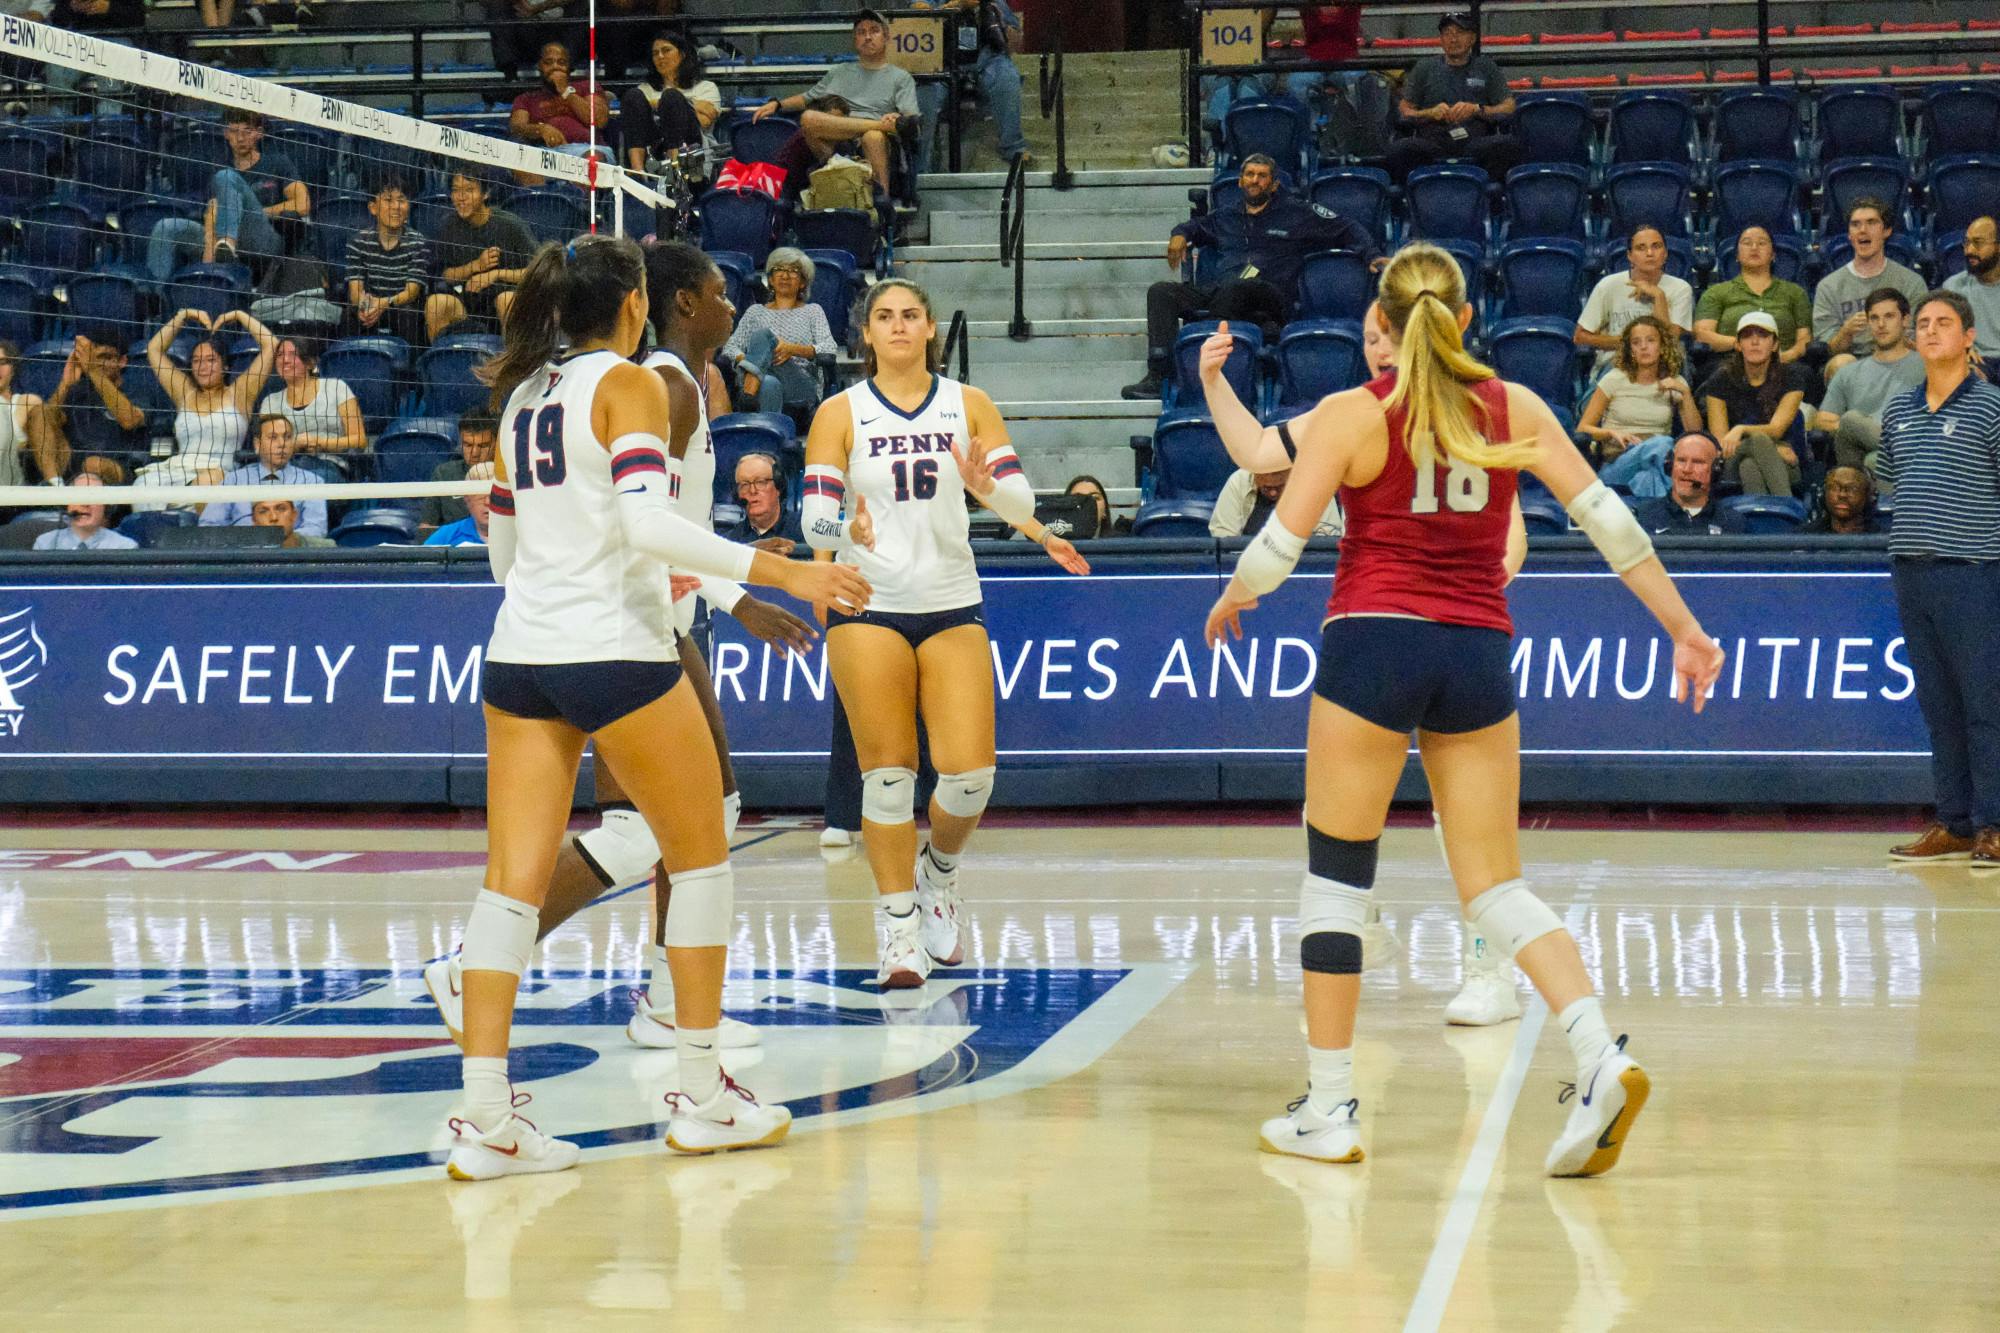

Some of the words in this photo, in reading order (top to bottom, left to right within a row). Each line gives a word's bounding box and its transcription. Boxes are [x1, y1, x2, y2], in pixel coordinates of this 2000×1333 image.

[3, 16, 36, 49] PENN
[38, 25, 108, 68] VOLLEYBALL
[893, 33, 934, 53] 103
[1210, 25, 1253, 46] 104
[178, 60, 205, 90] PENN
[207, 68, 263, 105] VOLLEYBALL
[321, 97, 344, 121] PENN
[345, 103, 393, 135] VOLLEYBALL
[440, 126, 459, 149] PENN
[541, 150, 557, 171] PENN
[513, 402, 567, 491] 19
[868, 432, 954, 458] PENN
[891, 458, 939, 502] 16
[1411, 431, 1489, 514] 18
[103, 644, 356, 705] SAFELY
[1149, 637, 1318, 699] AND
